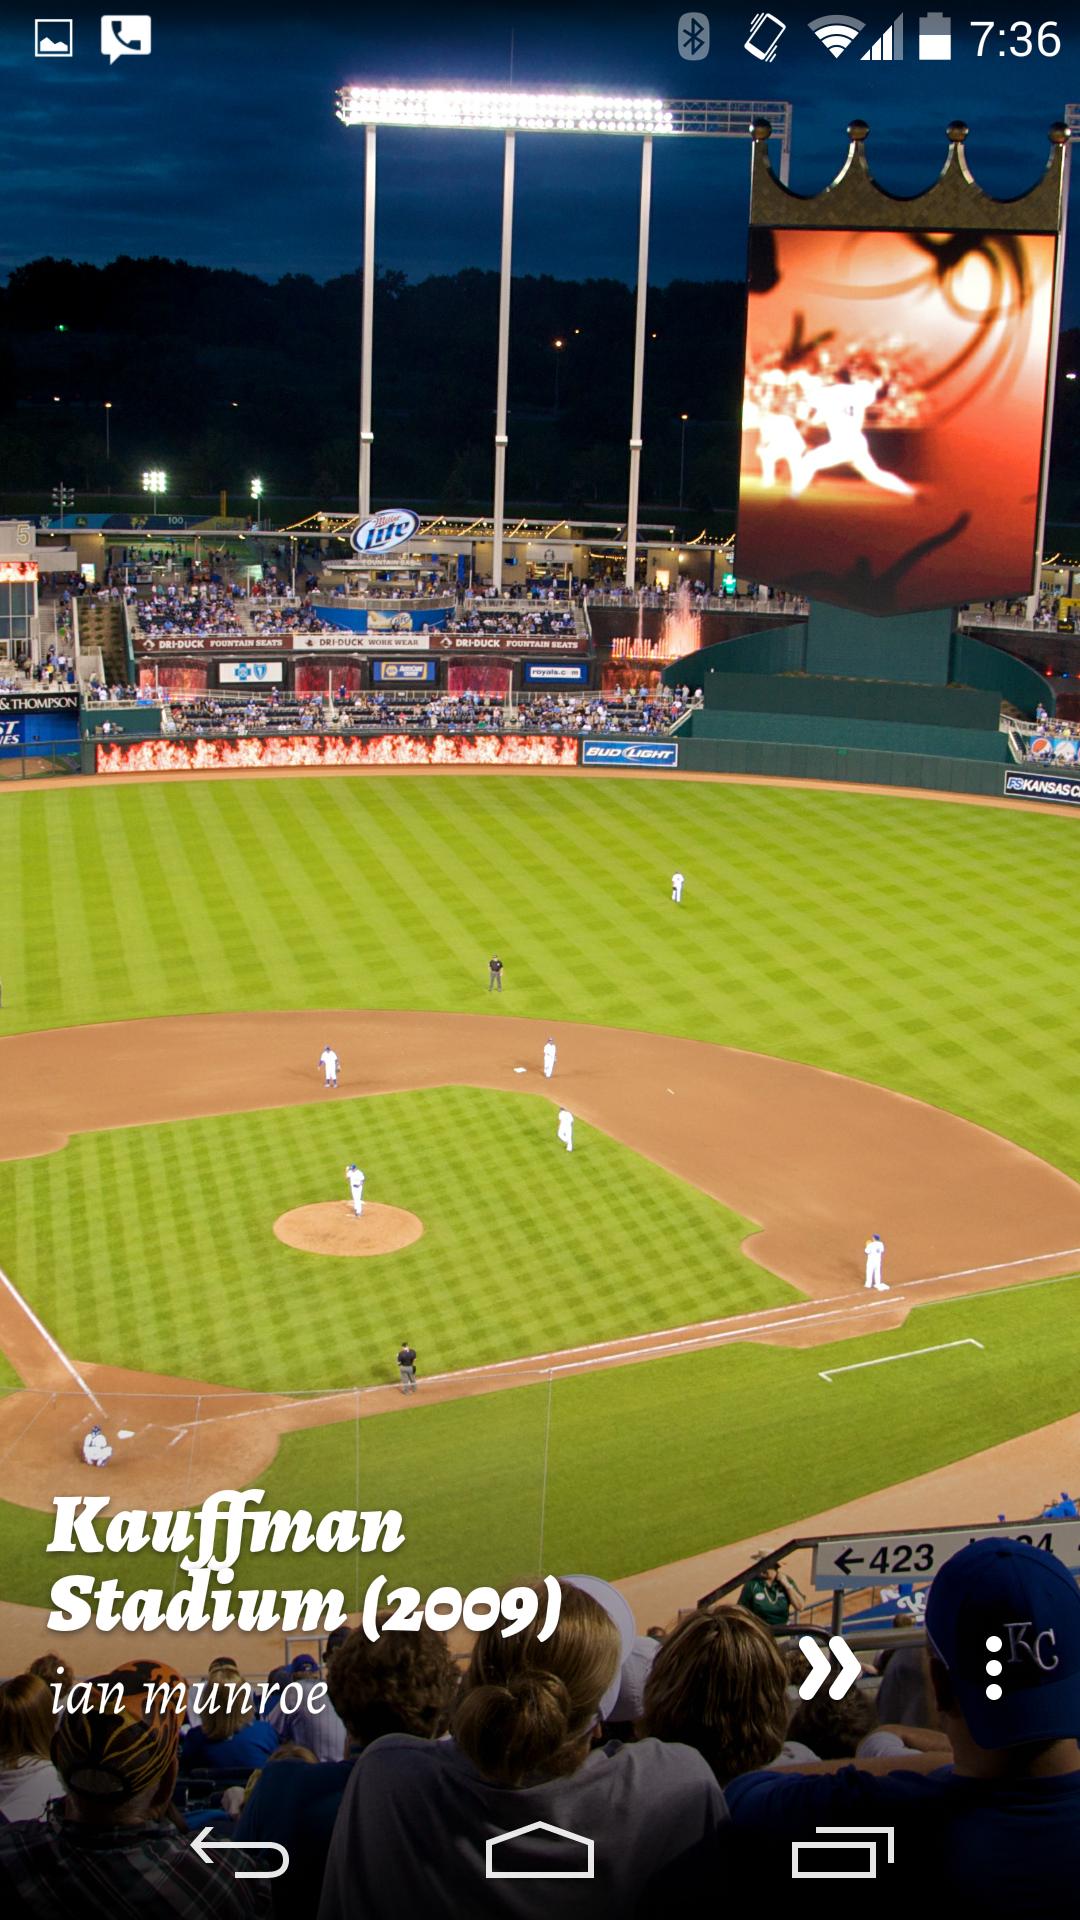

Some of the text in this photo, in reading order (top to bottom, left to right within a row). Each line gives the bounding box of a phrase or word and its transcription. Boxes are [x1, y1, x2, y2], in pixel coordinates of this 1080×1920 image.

[167, 516, 184, 525] 100
[16, 524, 31, 545] 5
[364, 521, 411, 550] Lite
[158, 639, 283, 649] DRI-DUCK FOUNTAIN SEATS
[319, 638, 418, 646] DRI-DUCK WORK WEAR
[455, 638, 578, 649] DRI-DUCK FOUNTAIN SEATS
[11, 696, 77, 709] THOMPSON
[586, 747, 674, 759] BUD LIGHT
[1023, 779, 1071, 796] KANSAS
[869, 1543, 935, 1574] 423
[1003, 1621, 1060, 1670] KC
